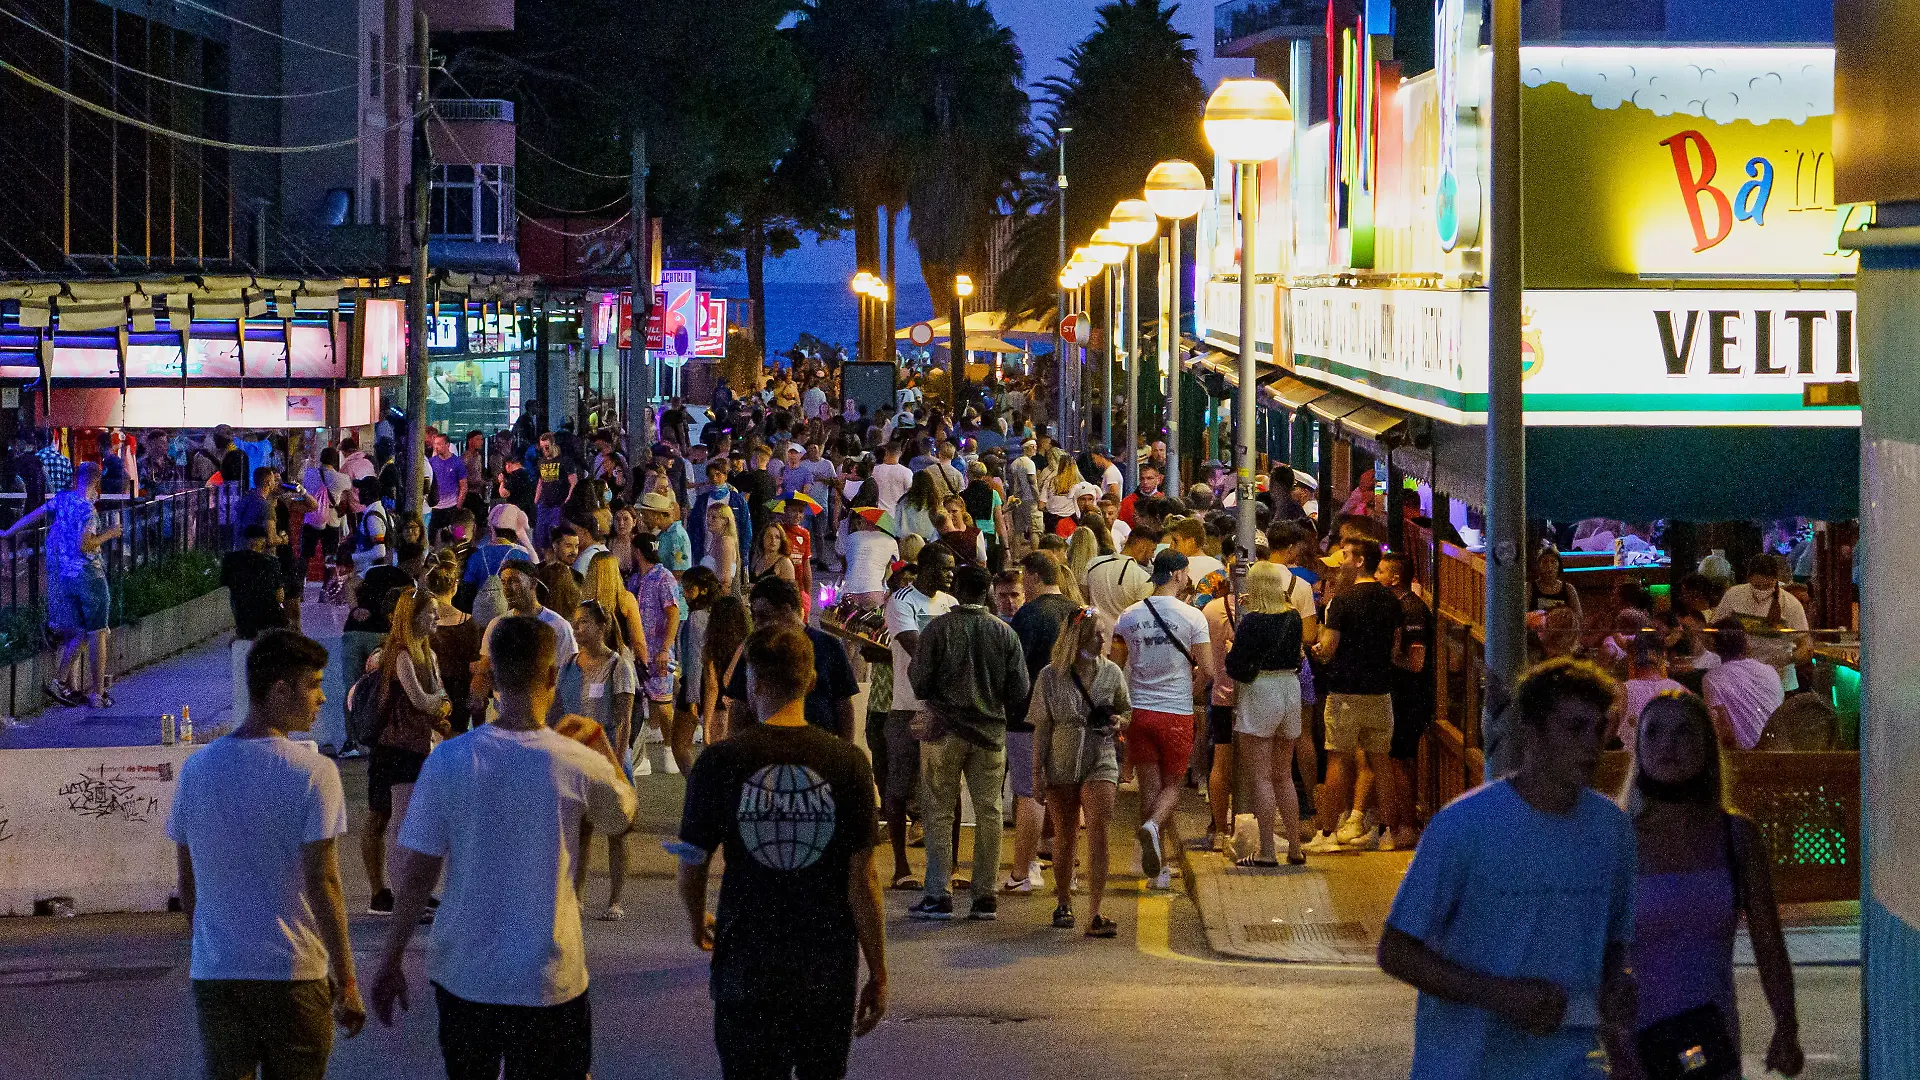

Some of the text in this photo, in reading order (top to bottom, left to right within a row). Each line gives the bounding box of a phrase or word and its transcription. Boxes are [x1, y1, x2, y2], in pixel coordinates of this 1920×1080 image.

[1063, 325, 1076, 333] ST
[1653, 310, 1856, 376] VELTI
[737, 782, 836, 813] HUMANS
